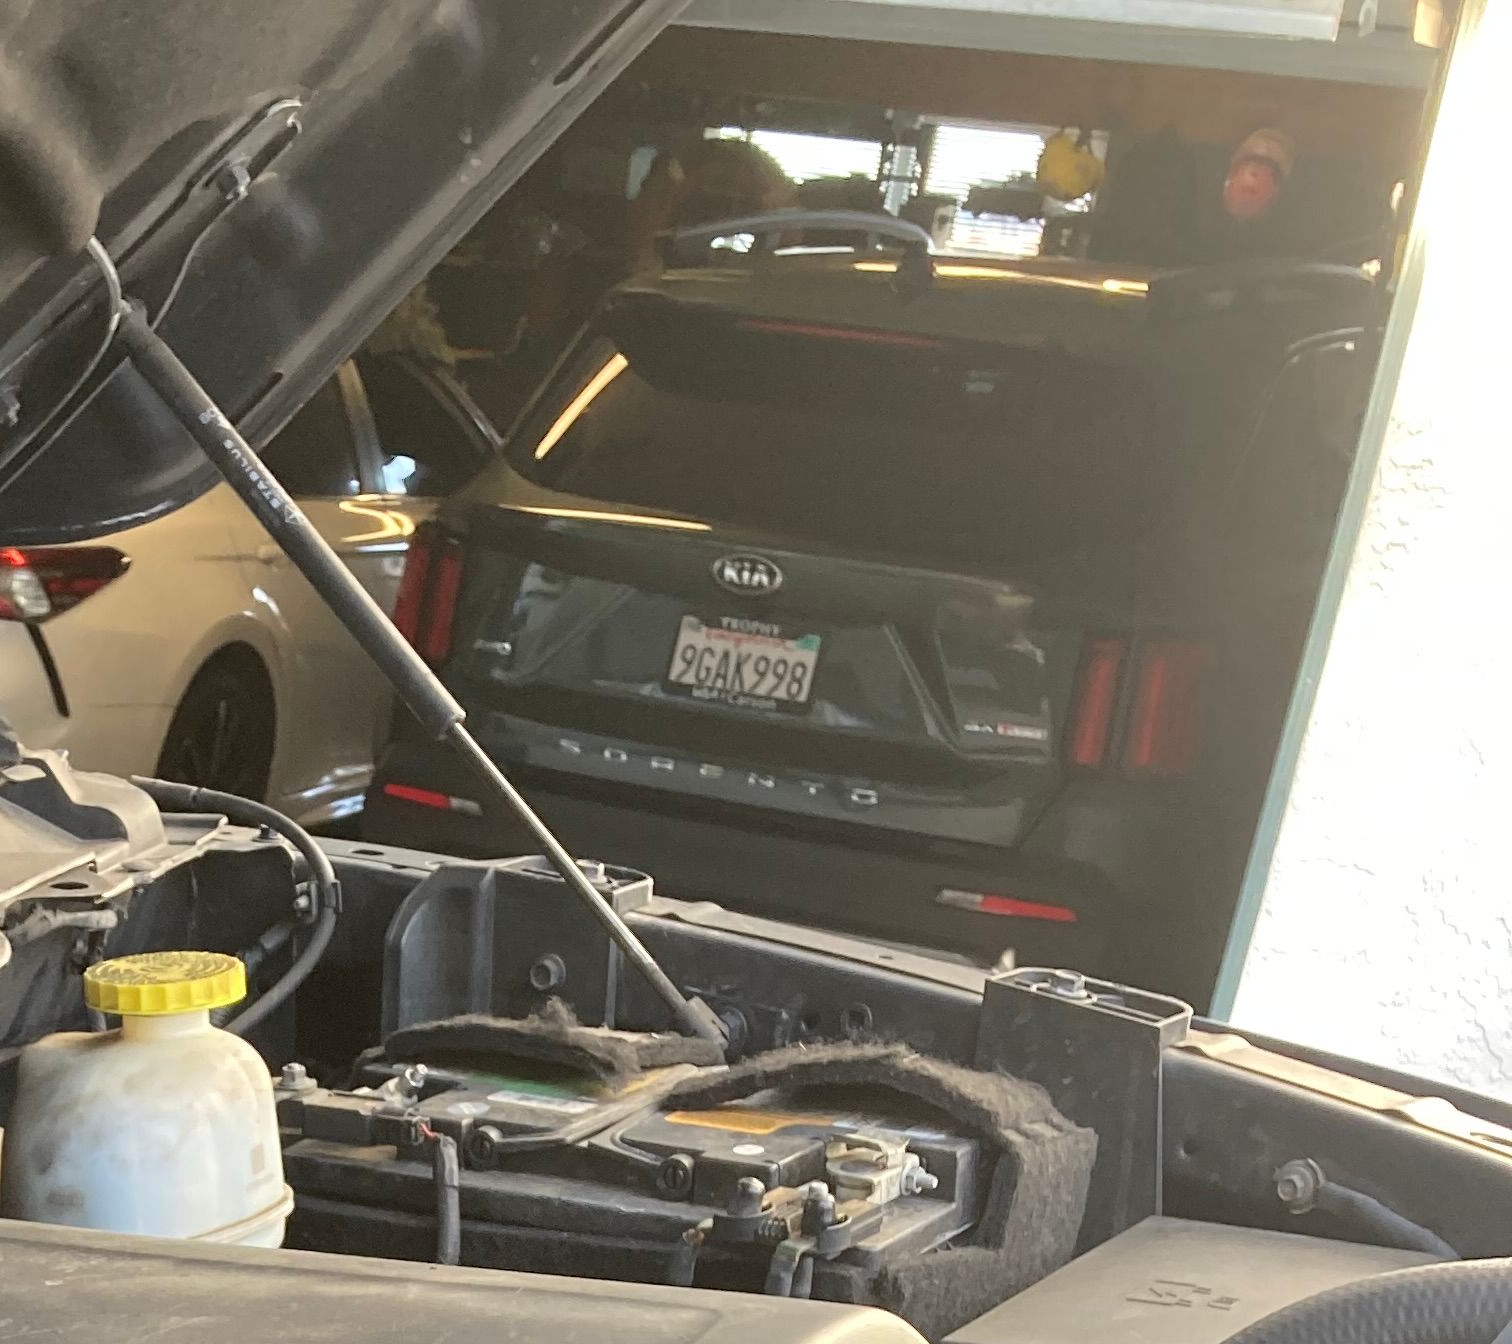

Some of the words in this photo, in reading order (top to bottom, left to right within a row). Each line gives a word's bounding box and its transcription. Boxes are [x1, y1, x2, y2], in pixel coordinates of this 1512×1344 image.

[222, 439, 281, 509] STABILUS
[721, 558, 772, 590] KIA
[676, 642, 809, 702] 9GAK998
[558, 735, 879, 807] SORENTO
